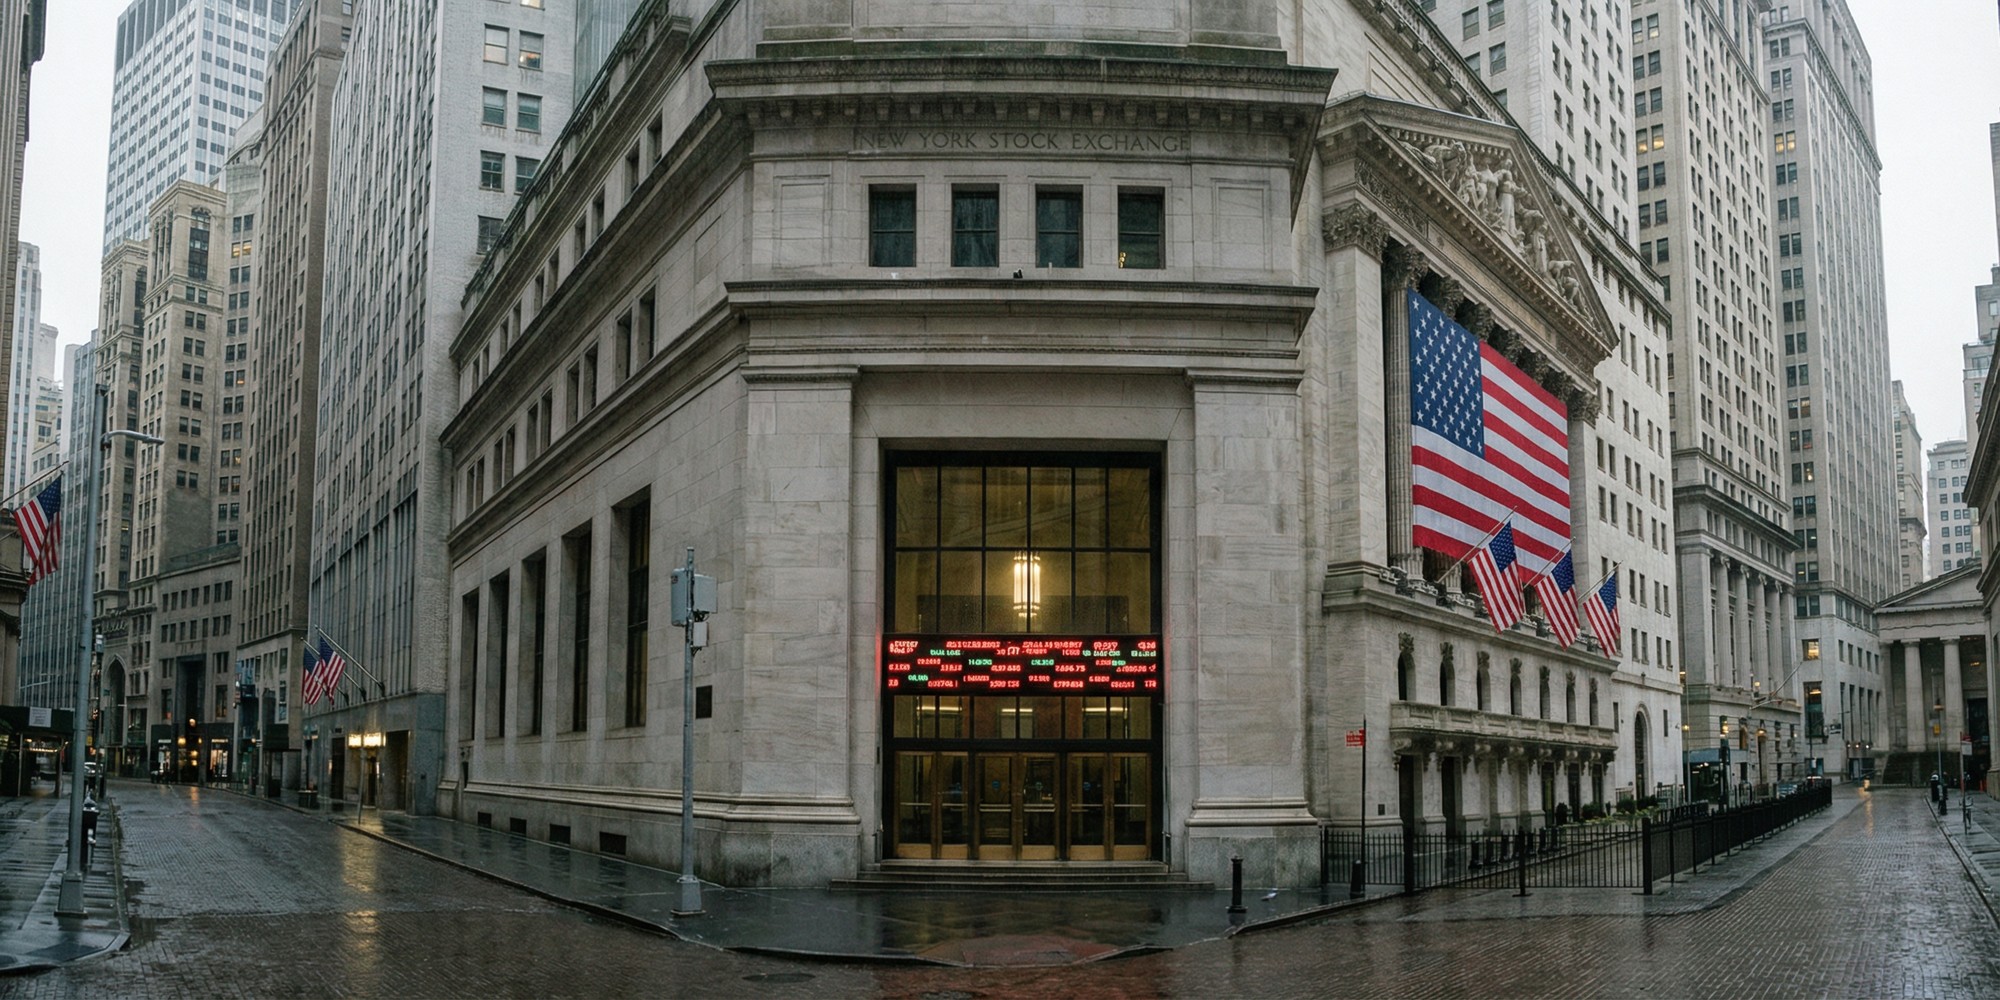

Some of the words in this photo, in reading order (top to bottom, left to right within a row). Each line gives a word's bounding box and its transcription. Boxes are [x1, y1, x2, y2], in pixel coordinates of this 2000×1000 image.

[858, 132, 909, 149] NEW
[919, 132, 977, 149] YORK
[989, 132, 1059, 149] STOCK
[1072, 133, 1190, 152] EXCHANGE
